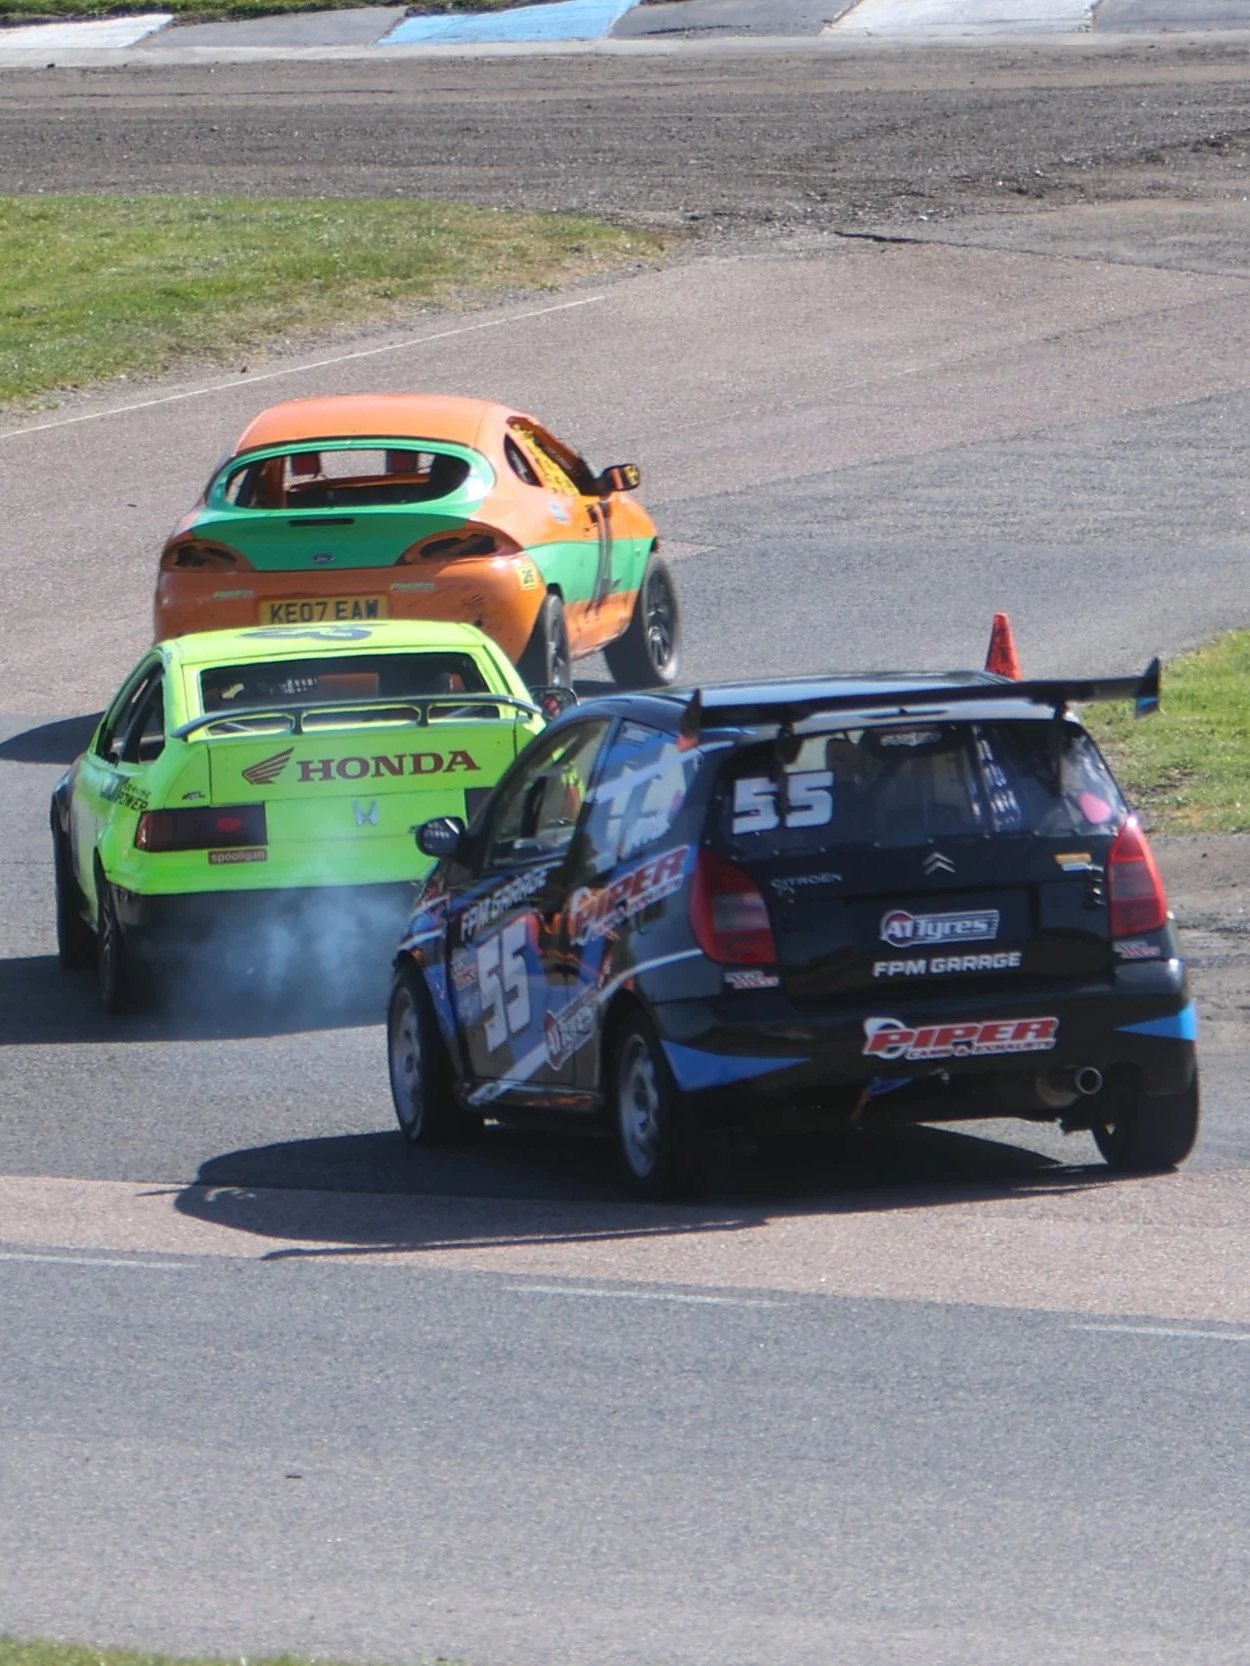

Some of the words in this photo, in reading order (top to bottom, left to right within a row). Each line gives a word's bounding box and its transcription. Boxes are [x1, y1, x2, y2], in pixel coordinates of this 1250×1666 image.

[270, 602, 327, 624] KE07
[335, 599, 379, 620] EAW
[296, 750, 481, 783] HONDA
[733, 771, 834, 834] 55
[211, 851, 265, 863] spooligan
[873, 959, 927, 977] FPM
[930, 952, 1022, 974] GARAGE
[477, 914, 531, 1053] 55
[866, 1018, 1058, 1053] PIPER
